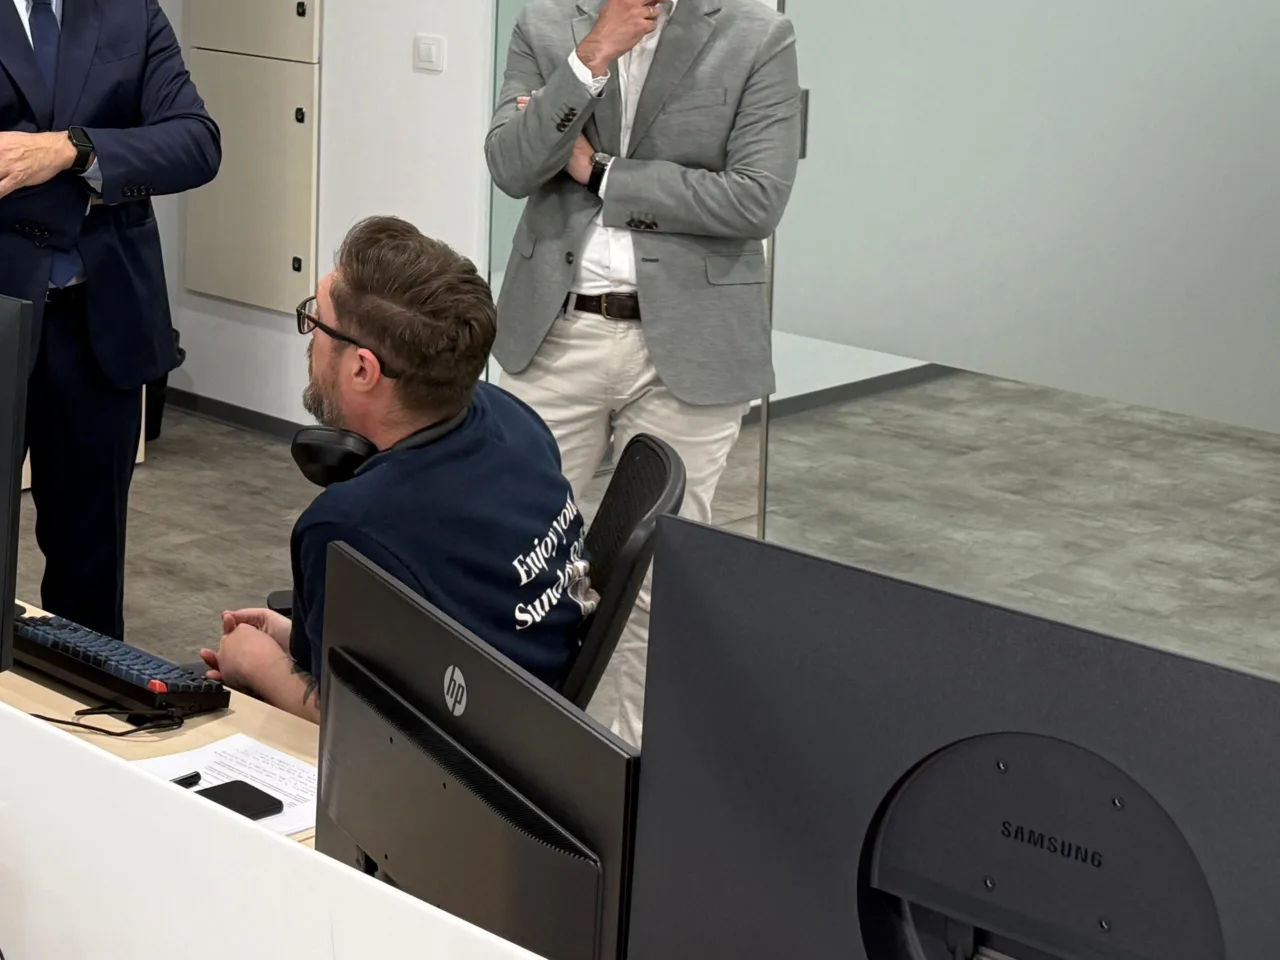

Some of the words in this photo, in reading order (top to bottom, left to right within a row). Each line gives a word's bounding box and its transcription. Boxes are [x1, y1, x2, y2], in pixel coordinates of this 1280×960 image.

[512, 527, 558, 586] Enjoy
[444, 665, 467, 716] hp
[1000, 820, 1103, 868] SAMSUNG
